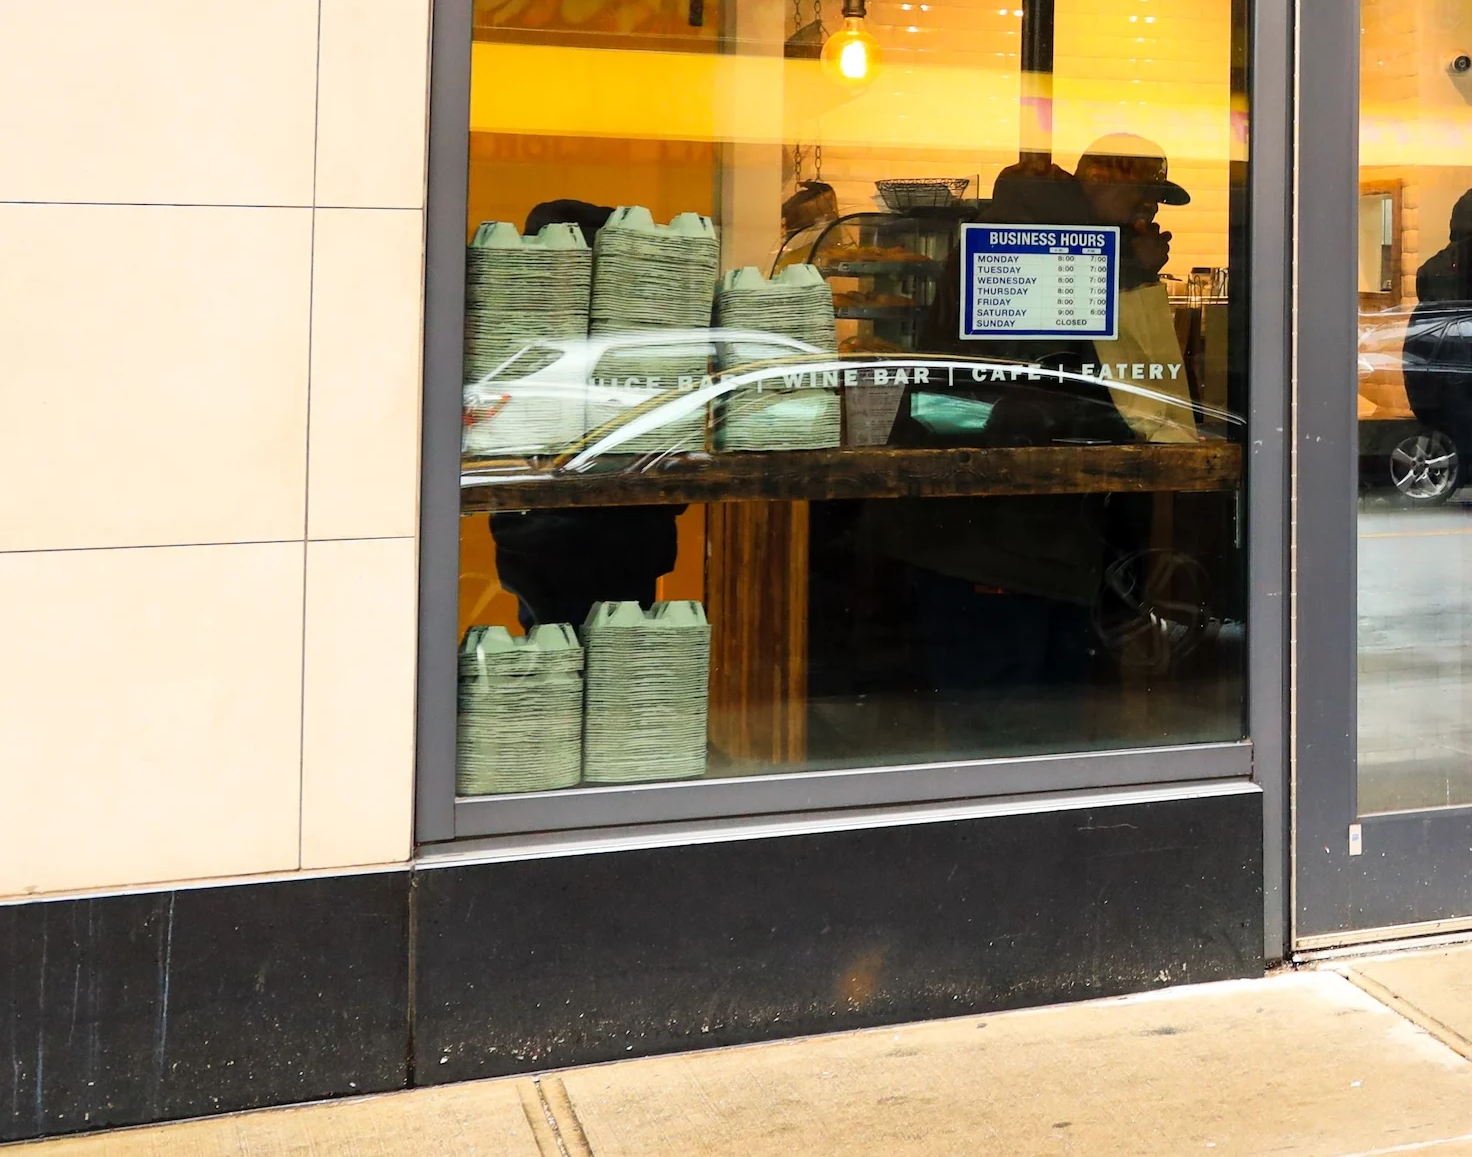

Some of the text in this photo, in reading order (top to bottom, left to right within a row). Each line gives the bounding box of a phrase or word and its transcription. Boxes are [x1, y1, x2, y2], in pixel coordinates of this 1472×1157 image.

[989, 232, 1106, 248] BUSINESS HOURS
[977, 255, 1019, 263] MONDAY
[978, 266, 1021, 274] TUESDAY
[977, 277, 1037, 285] WEDNESDAY
[977, 287, 1029, 295] THURSDAY
[977, 298, 1011, 306] FRIDAY
[976, 309, 1027, 317] SATURDAY
[976, 320, 1016, 328] SUNDAY
[782, 369, 858, 390] WINE
[873, 367, 930, 386] BAR
[1081, 363, 1183, 382] EATERY
